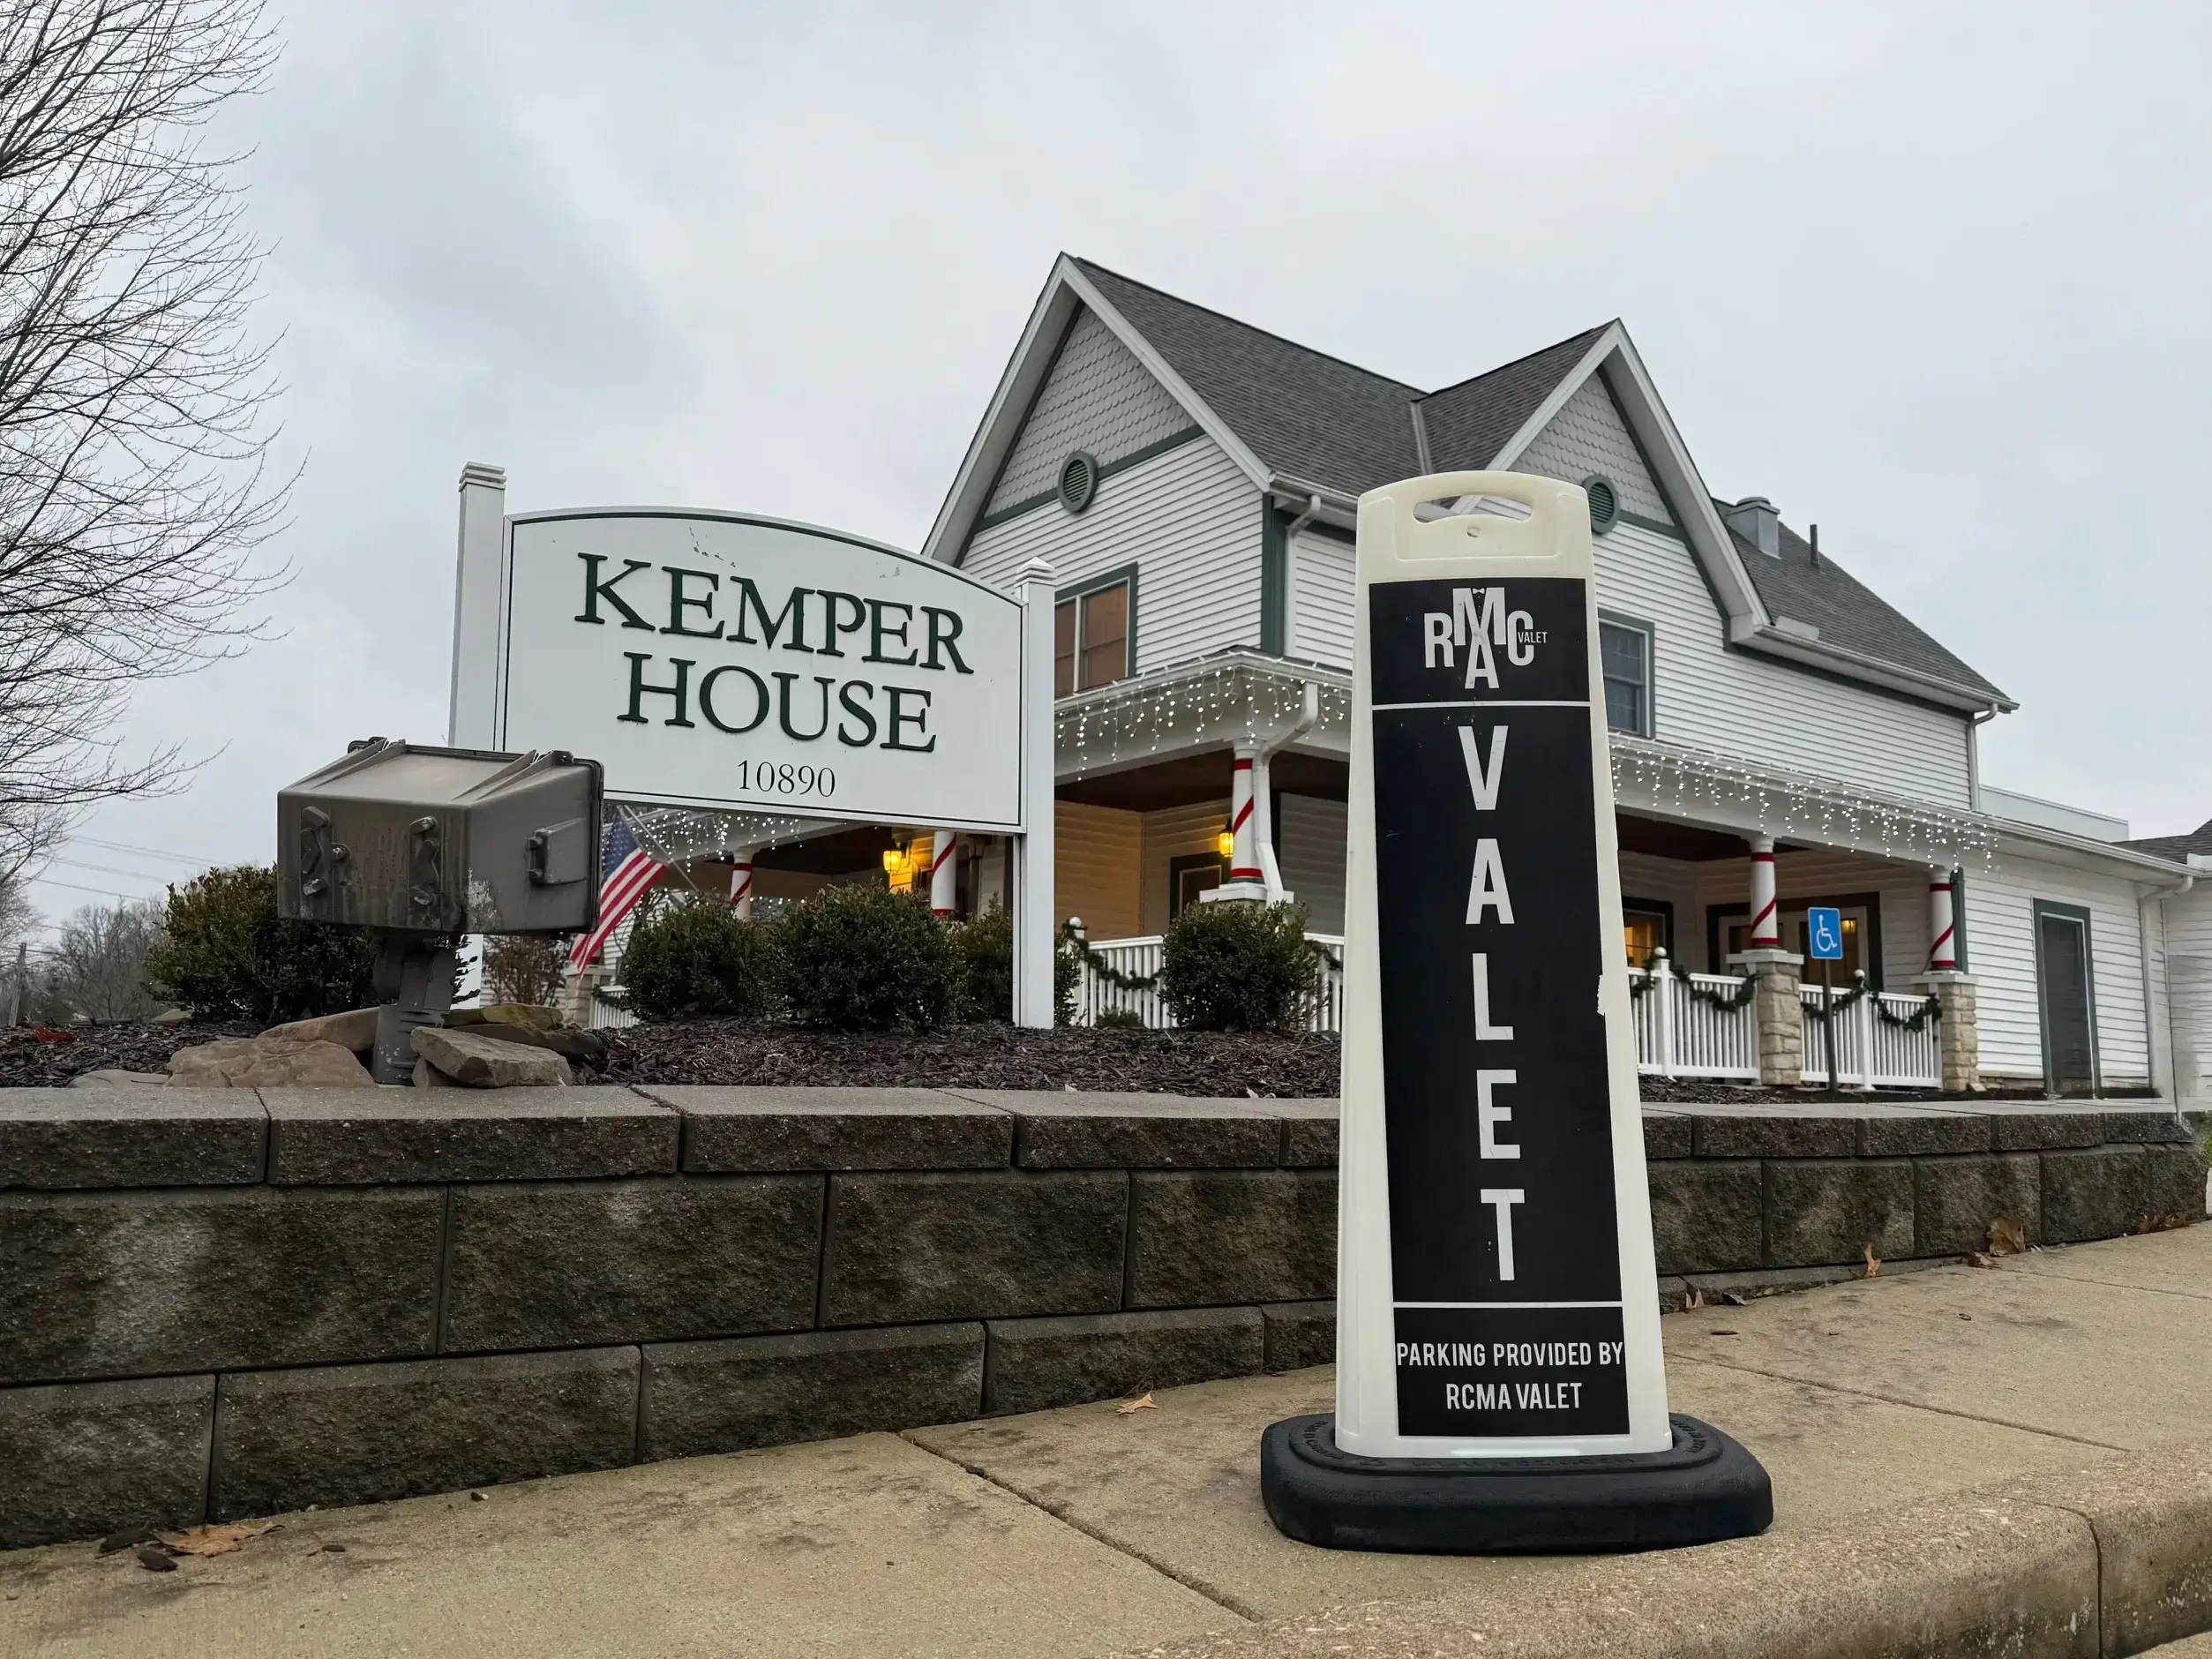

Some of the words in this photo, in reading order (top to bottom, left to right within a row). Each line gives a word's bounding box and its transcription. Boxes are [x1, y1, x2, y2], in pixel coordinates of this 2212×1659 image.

[574, 552, 974, 674] KEMPER
[1518, 631, 1548, 643] VALET
[616, 651, 937, 754] HOUSE
[738, 760, 836, 798] 10890
[1458, 724, 1526, 1281] VALET
[1397, 1342, 1486, 1367] PARKING
[1493, 1342, 1592, 1367] PROVIDED
[1598, 1341, 1623, 1365] BY
[1446, 1383, 1512, 1410] RCMA
[1515, 1382, 1582, 1410] VALET
